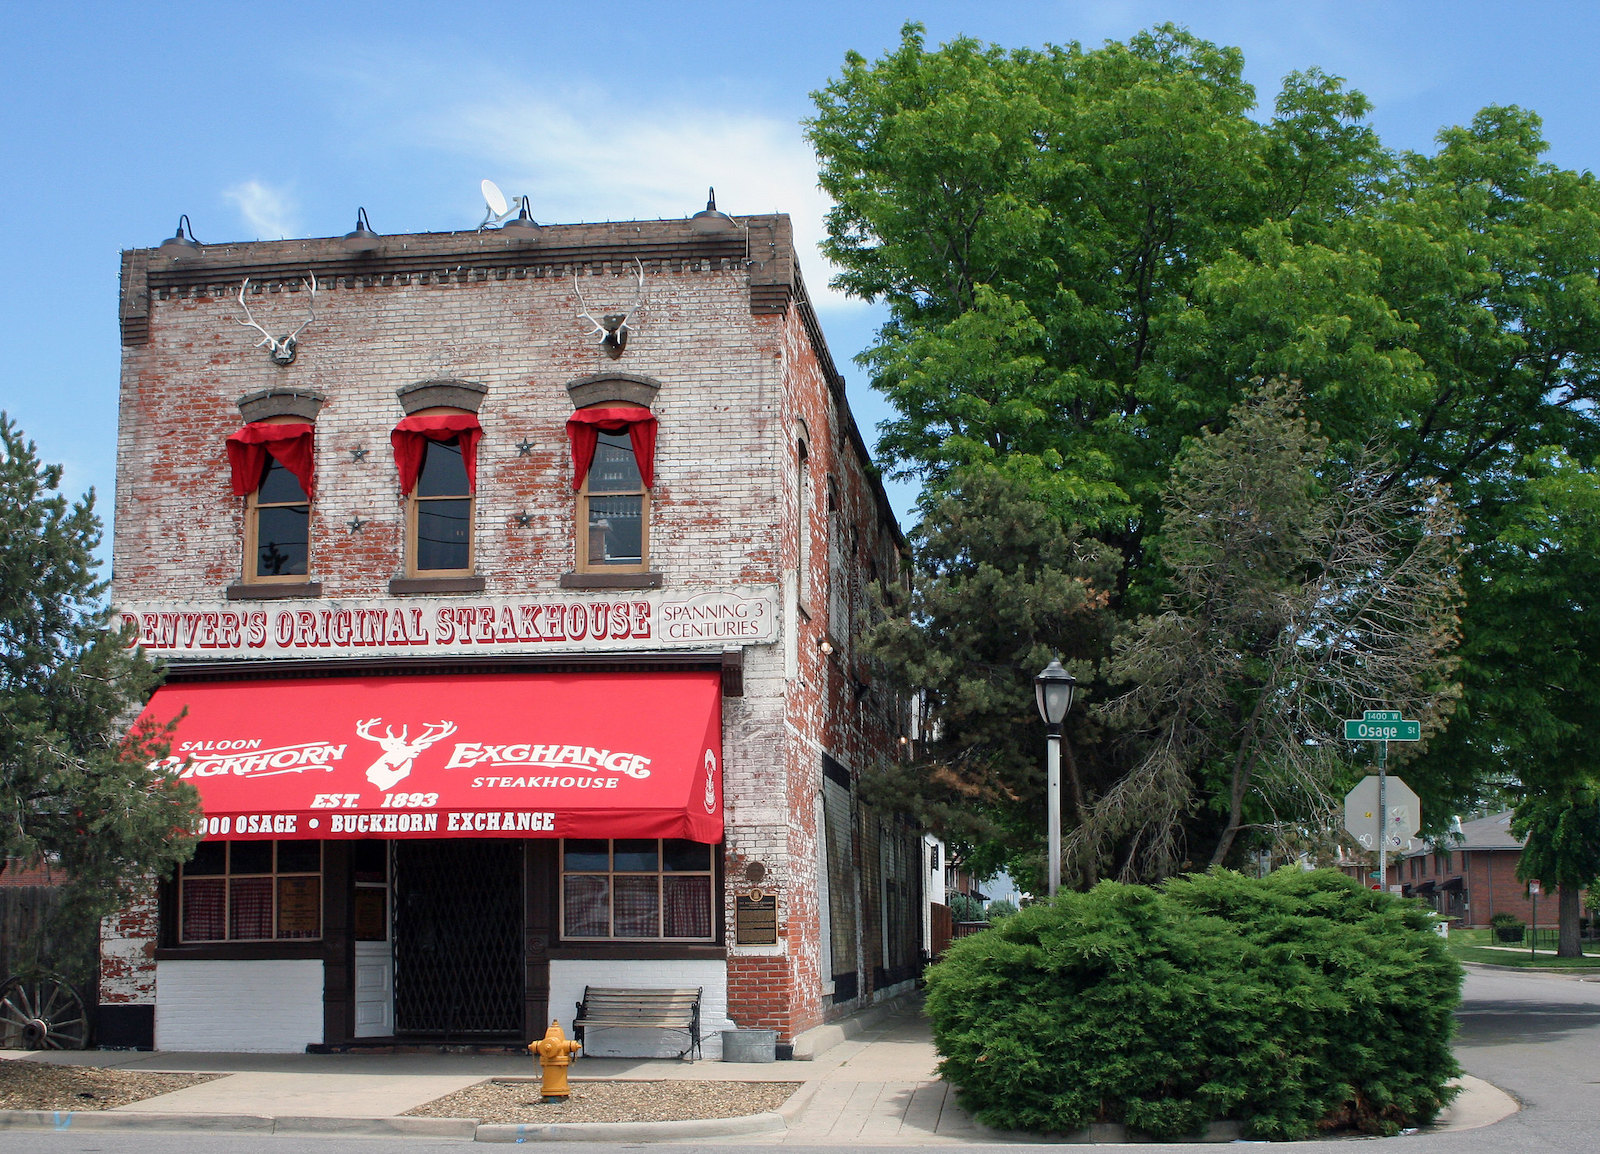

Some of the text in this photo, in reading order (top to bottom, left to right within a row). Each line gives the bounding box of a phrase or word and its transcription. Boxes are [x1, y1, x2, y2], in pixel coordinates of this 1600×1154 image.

[663, 602, 764, 620] SPANNING 3
[119, 600, 650, 648] DENVER'S ORIGINAL STEAKHOUSE
[669, 620, 759, 638] CENTURIES
[1367, 712, 1399, 720] 1400 W
[1358, 723, 1415, 738] Osage St
[178, 738, 262, 752] SALOON
[444, 742, 651, 779] EXCHANGE
[471, 776, 619, 789] STEAKHOUSE
[310, 792, 439, 808] EST. 1893
[235, 814, 297, 834] OSAGE
[330, 813, 438, 833] BUCKHORN
[446, 812, 555, 831] EXCHANGE
